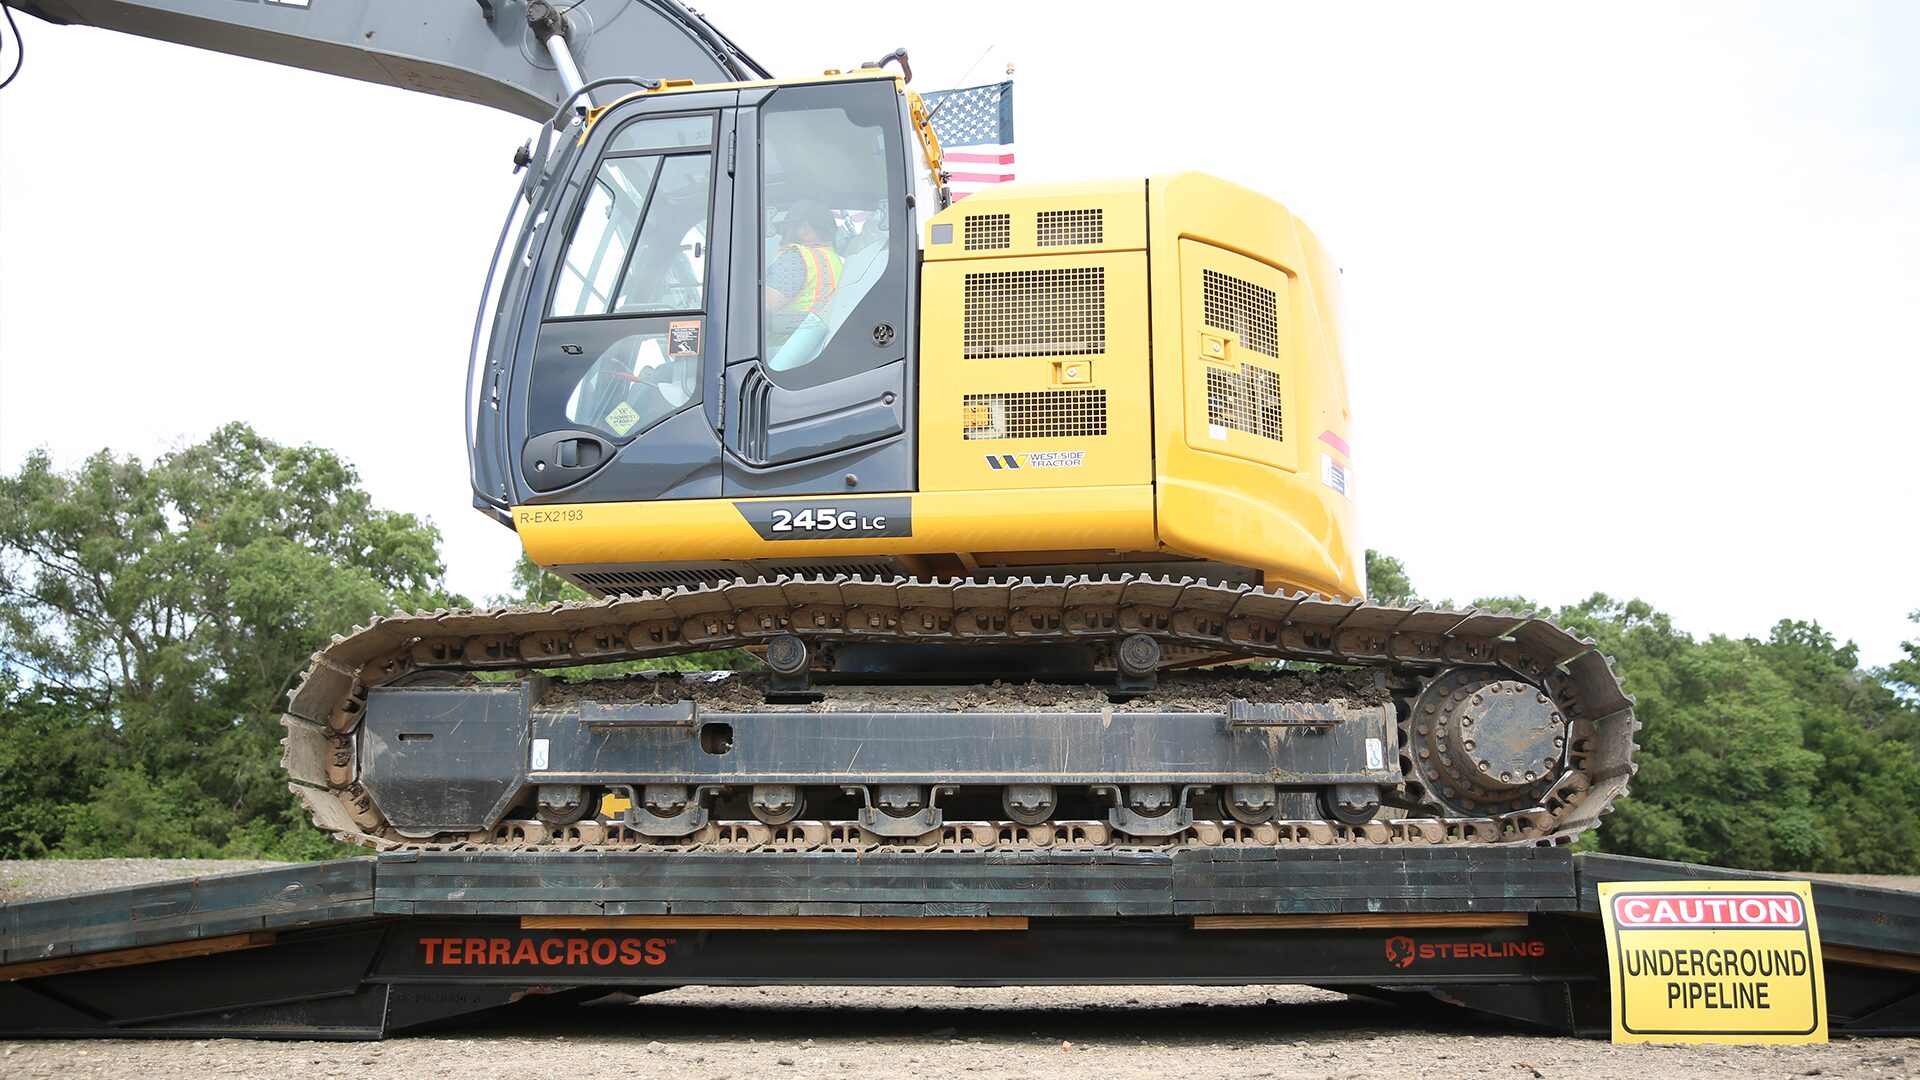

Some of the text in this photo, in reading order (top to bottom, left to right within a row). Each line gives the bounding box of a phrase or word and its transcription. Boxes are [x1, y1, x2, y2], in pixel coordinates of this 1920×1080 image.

[520, 509, 583, 523] R-EX2193
[772, 509, 886, 531] 245G LC
[1624, 899, 1794, 923] CAUTION
[1419, 941, 1545, 959] STERLING
[1625, 949, 1807, 976] UNDERGROUND
[1667, 982, 1770, 1009] PIPELINE
